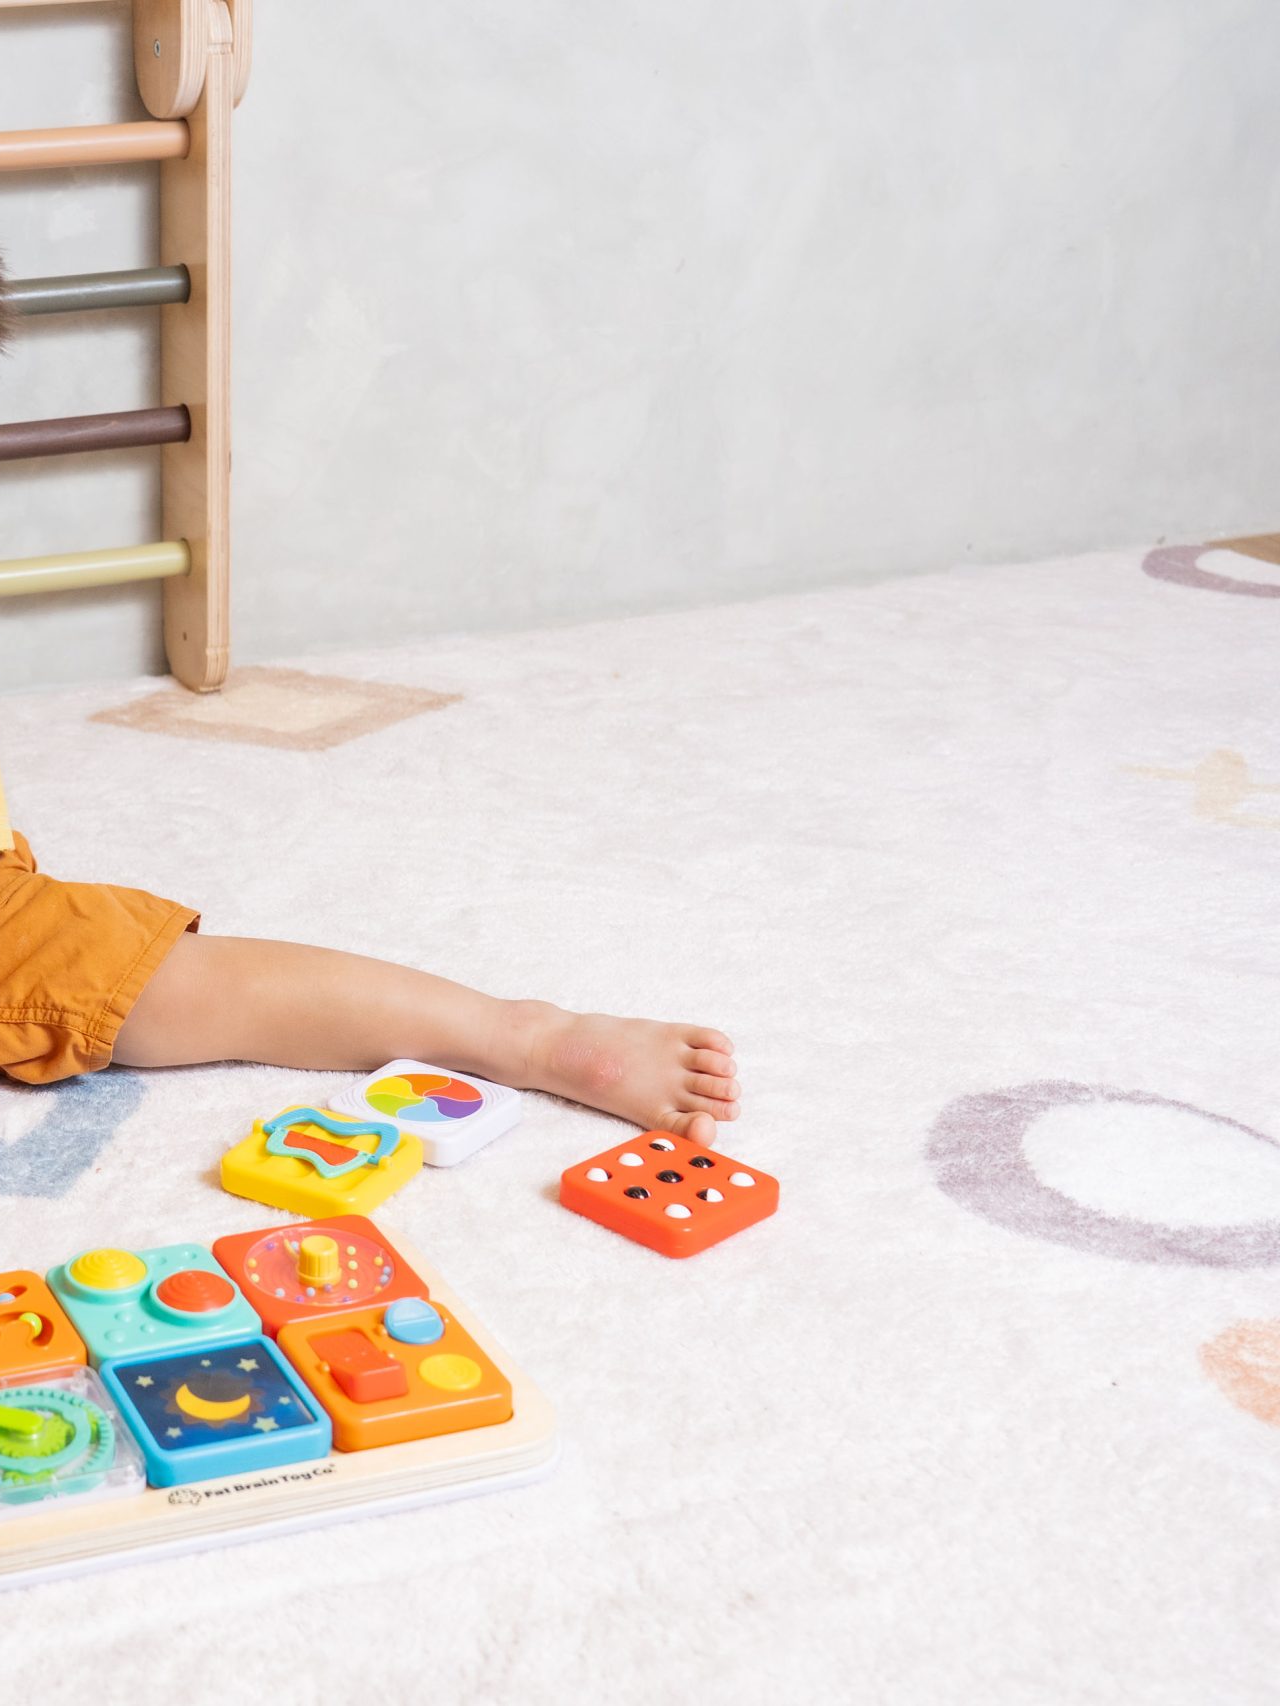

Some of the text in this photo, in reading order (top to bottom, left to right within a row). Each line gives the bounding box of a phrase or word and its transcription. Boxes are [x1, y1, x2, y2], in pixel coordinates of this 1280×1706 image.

[204, 1487, 230, 1498] Fat
[233, 1478, 279, 1492] Brain
[279, 1472, 312, 1483] Toy
